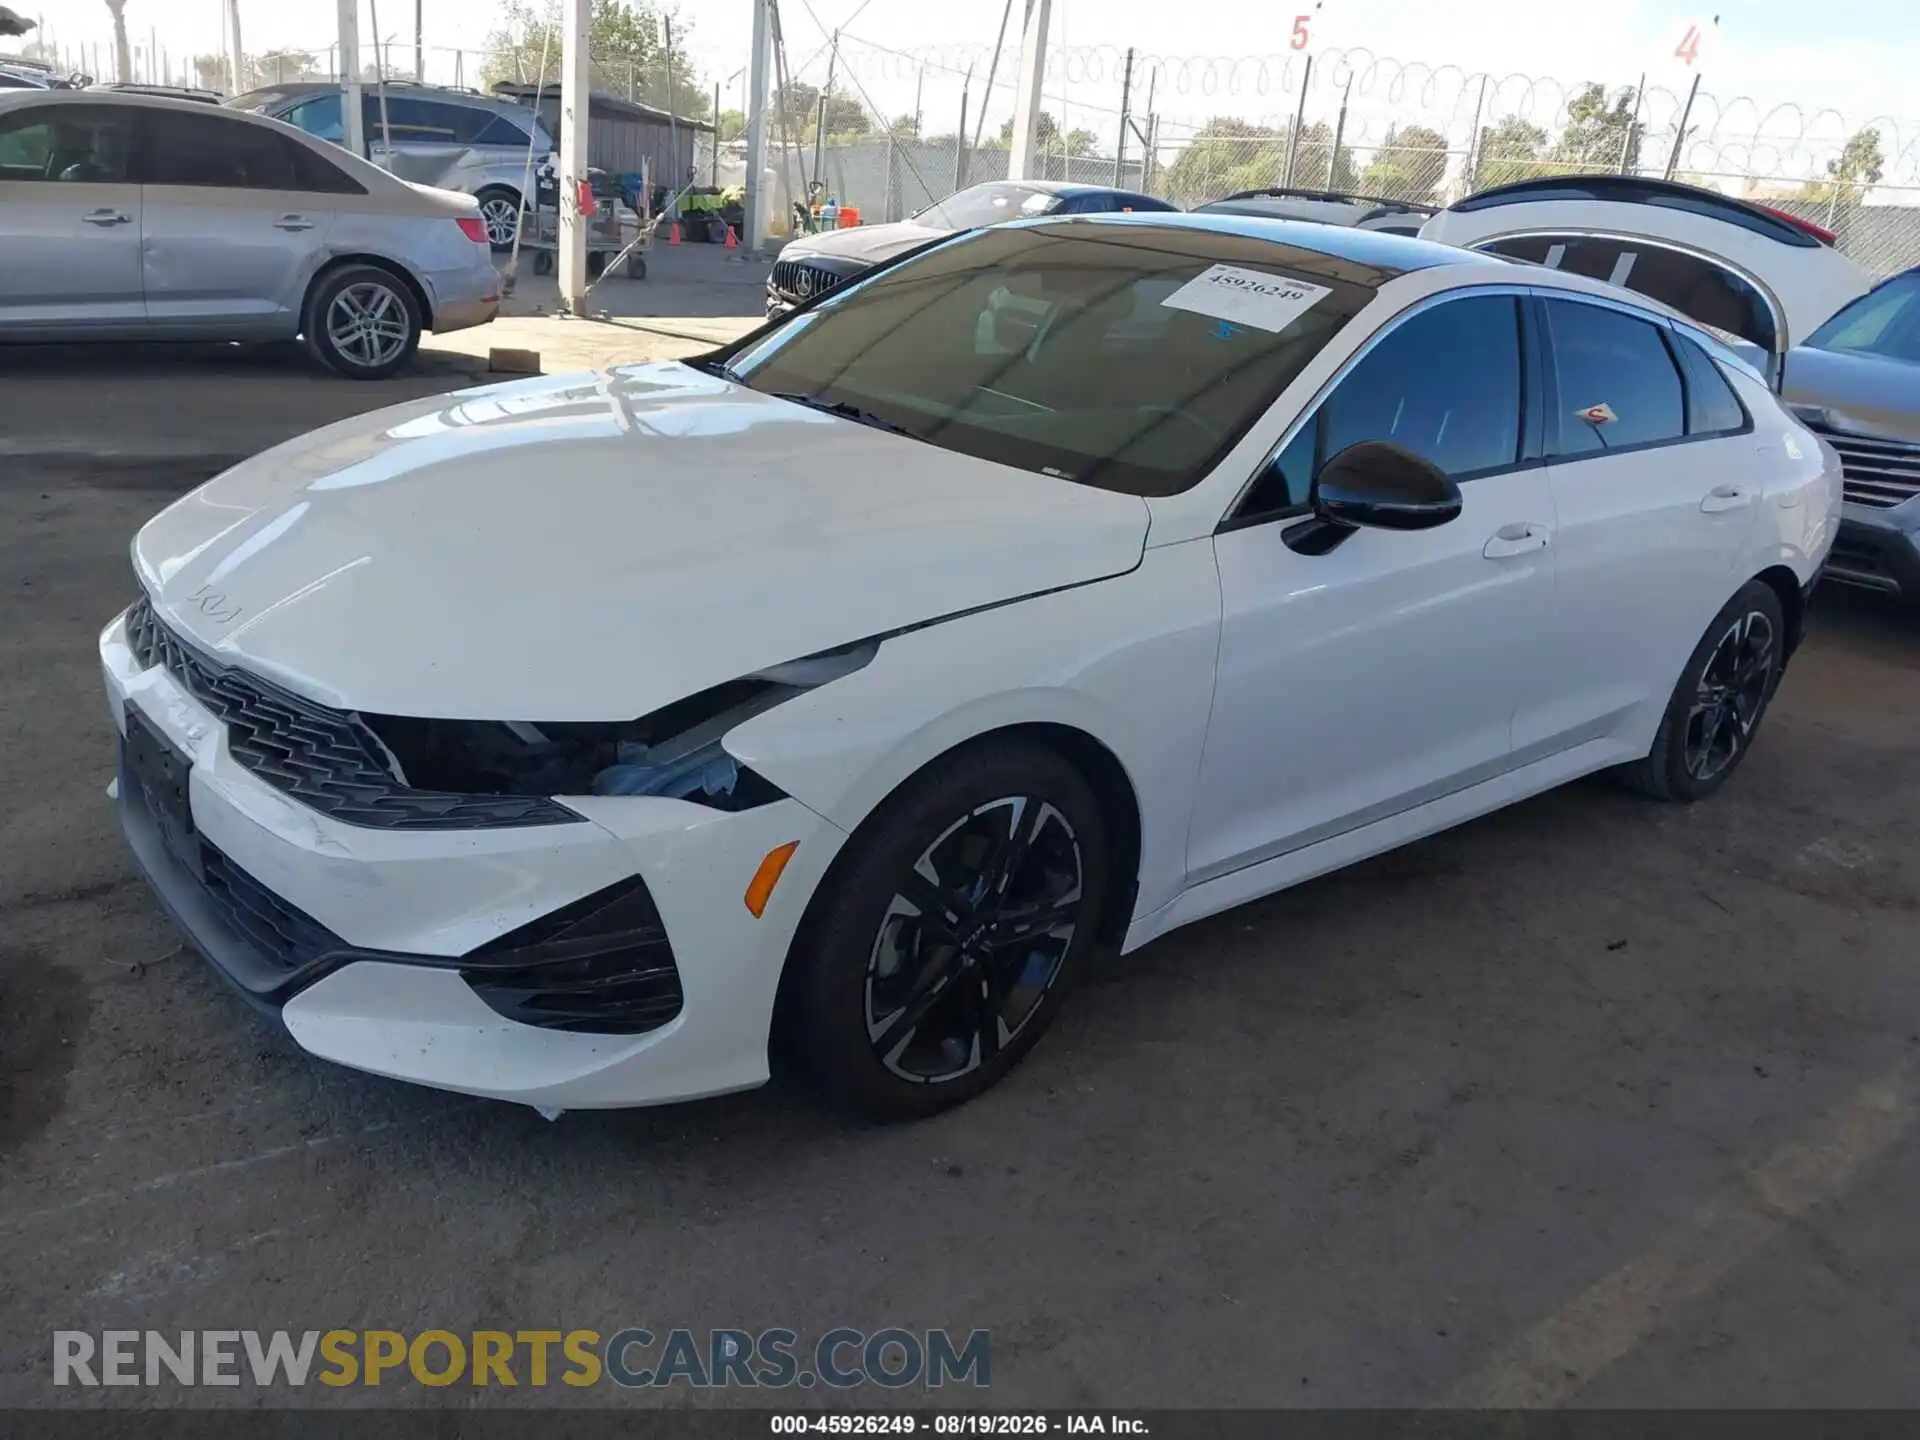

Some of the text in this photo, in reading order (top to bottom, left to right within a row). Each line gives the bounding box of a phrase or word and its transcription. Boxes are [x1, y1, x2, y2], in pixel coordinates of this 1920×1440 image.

[1290, 15, 1311, 50] 5
[1674, 25, 1701, 66] 4
[1209, 274, 1305, 300] 45926249
